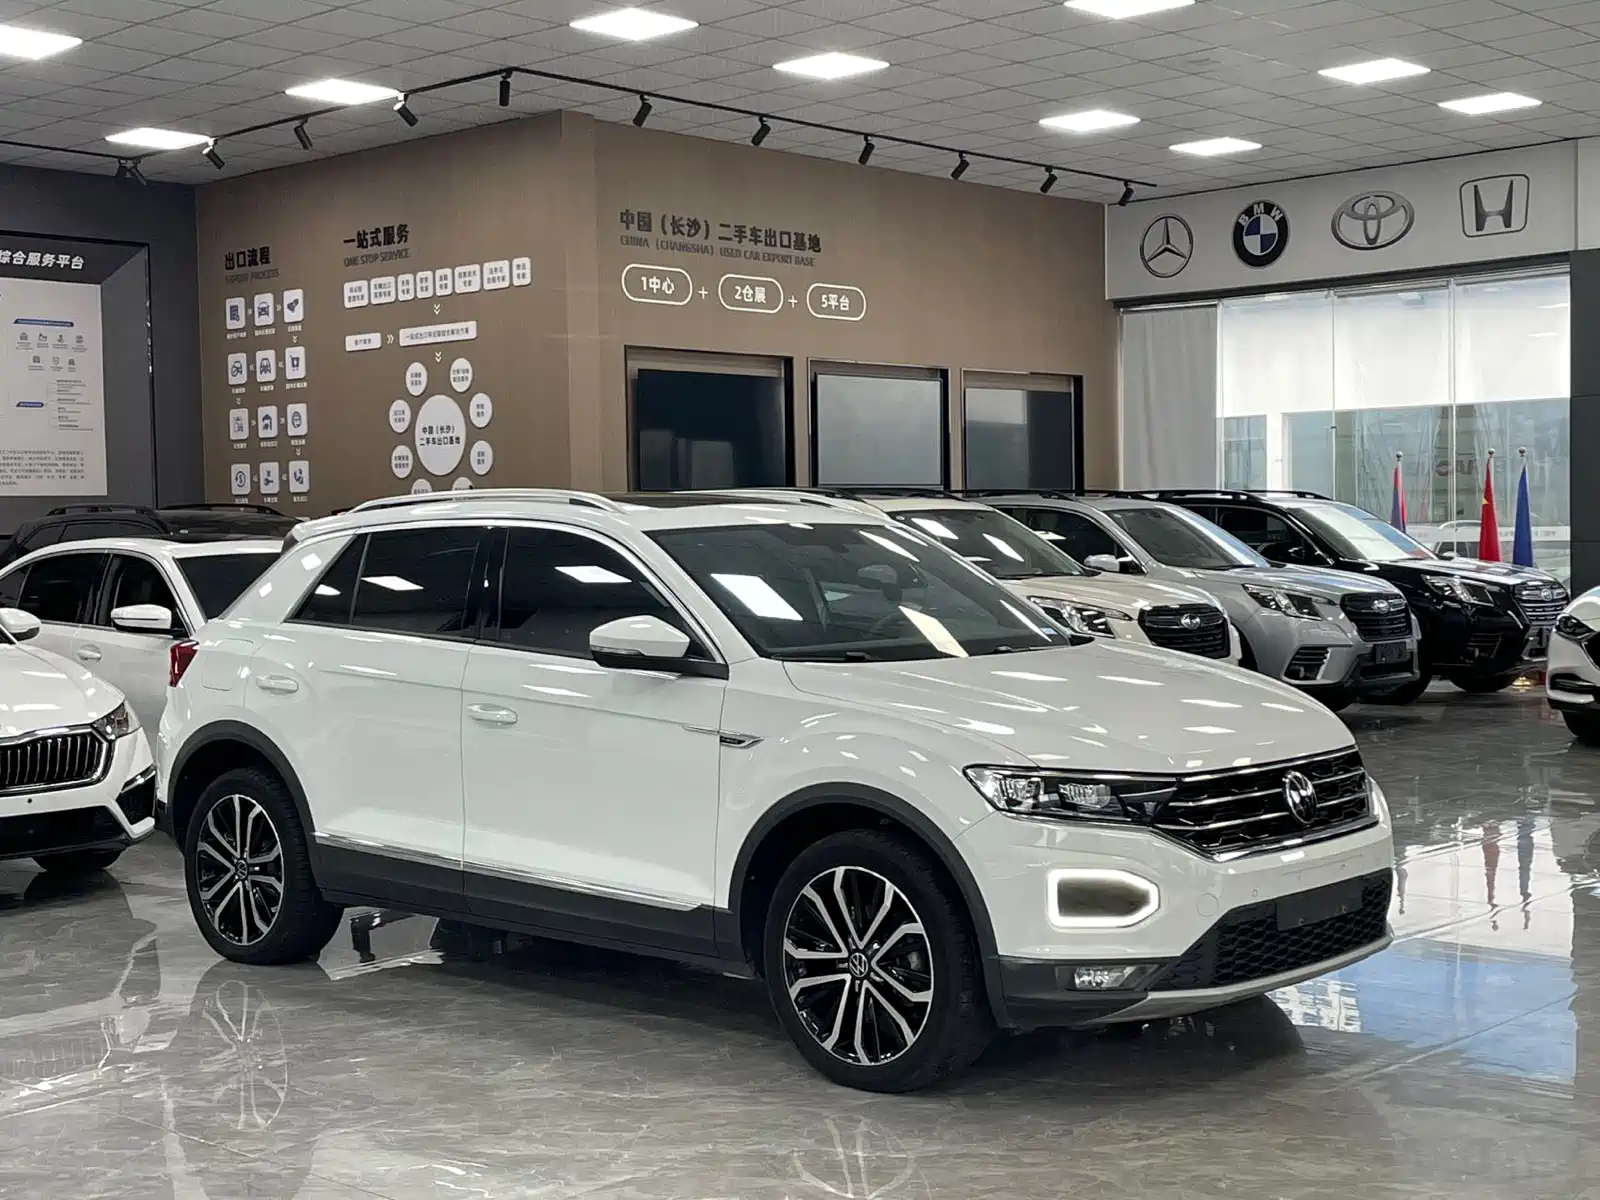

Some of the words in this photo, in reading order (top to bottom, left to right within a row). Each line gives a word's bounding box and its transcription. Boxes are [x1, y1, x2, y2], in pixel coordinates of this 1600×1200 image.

[1238, 202, 1284, 227] BMW
[343, 223, 410, 249] 一站式服务
[0, 249, 85, 270] 综合服务平台
[224, 246, 271, 270] 出口流程
[343, 256, 360, 267] ONE
[360, 253, 380, 265] STOP
[380, 248, 411, 262] SERVICE
[619, 235, 650, 249] CHINA
[719, 247, 742, 259] USED
[743, 250, 762, 262] CAR
[762, 252, 793, 265] EXPORT
[794, 256, 817, 268] BASE
[640, 275, 676, 295] 1中心
[821, 294, 850, 312] 5平台
[419, 436, 461, 446] 二手车出口基地
